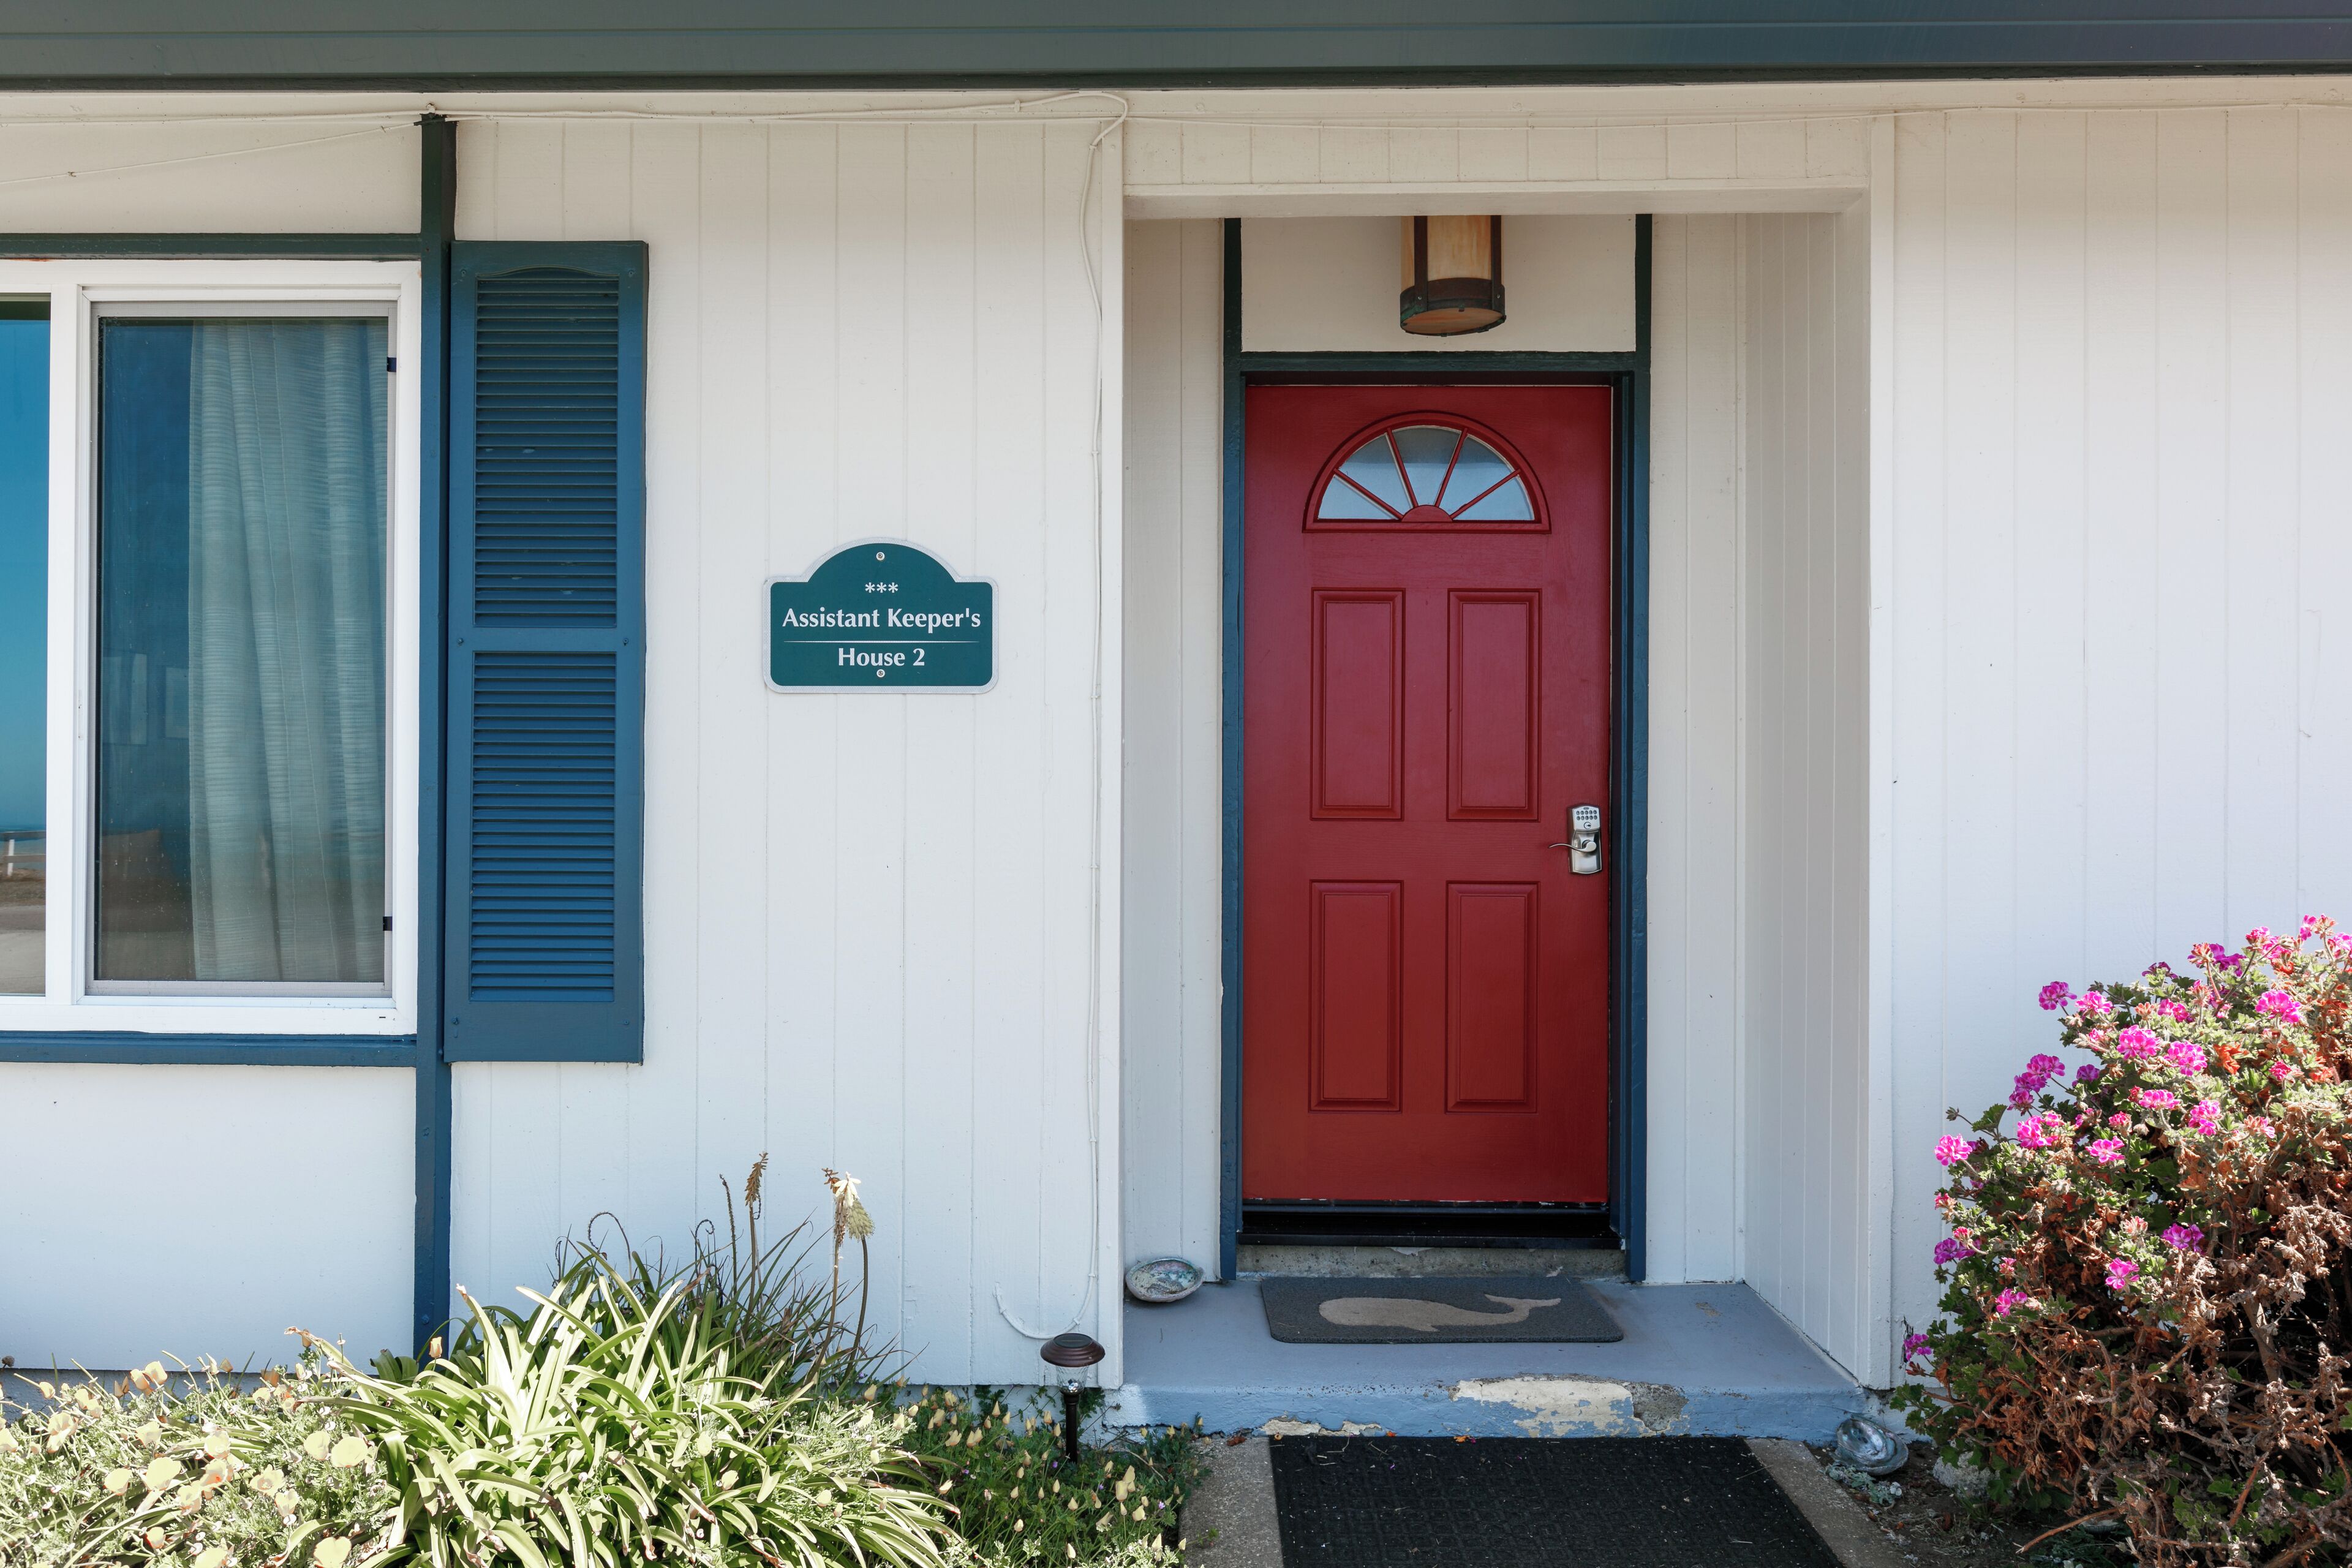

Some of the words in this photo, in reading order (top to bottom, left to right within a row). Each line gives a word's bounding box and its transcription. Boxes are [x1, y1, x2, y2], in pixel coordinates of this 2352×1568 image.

[782, 607, 880, 628] Assistant
[888, 608, 981, 634] Keeper's
[839, 648, 905, 666] House
[913, 648, 925, 666] 2
